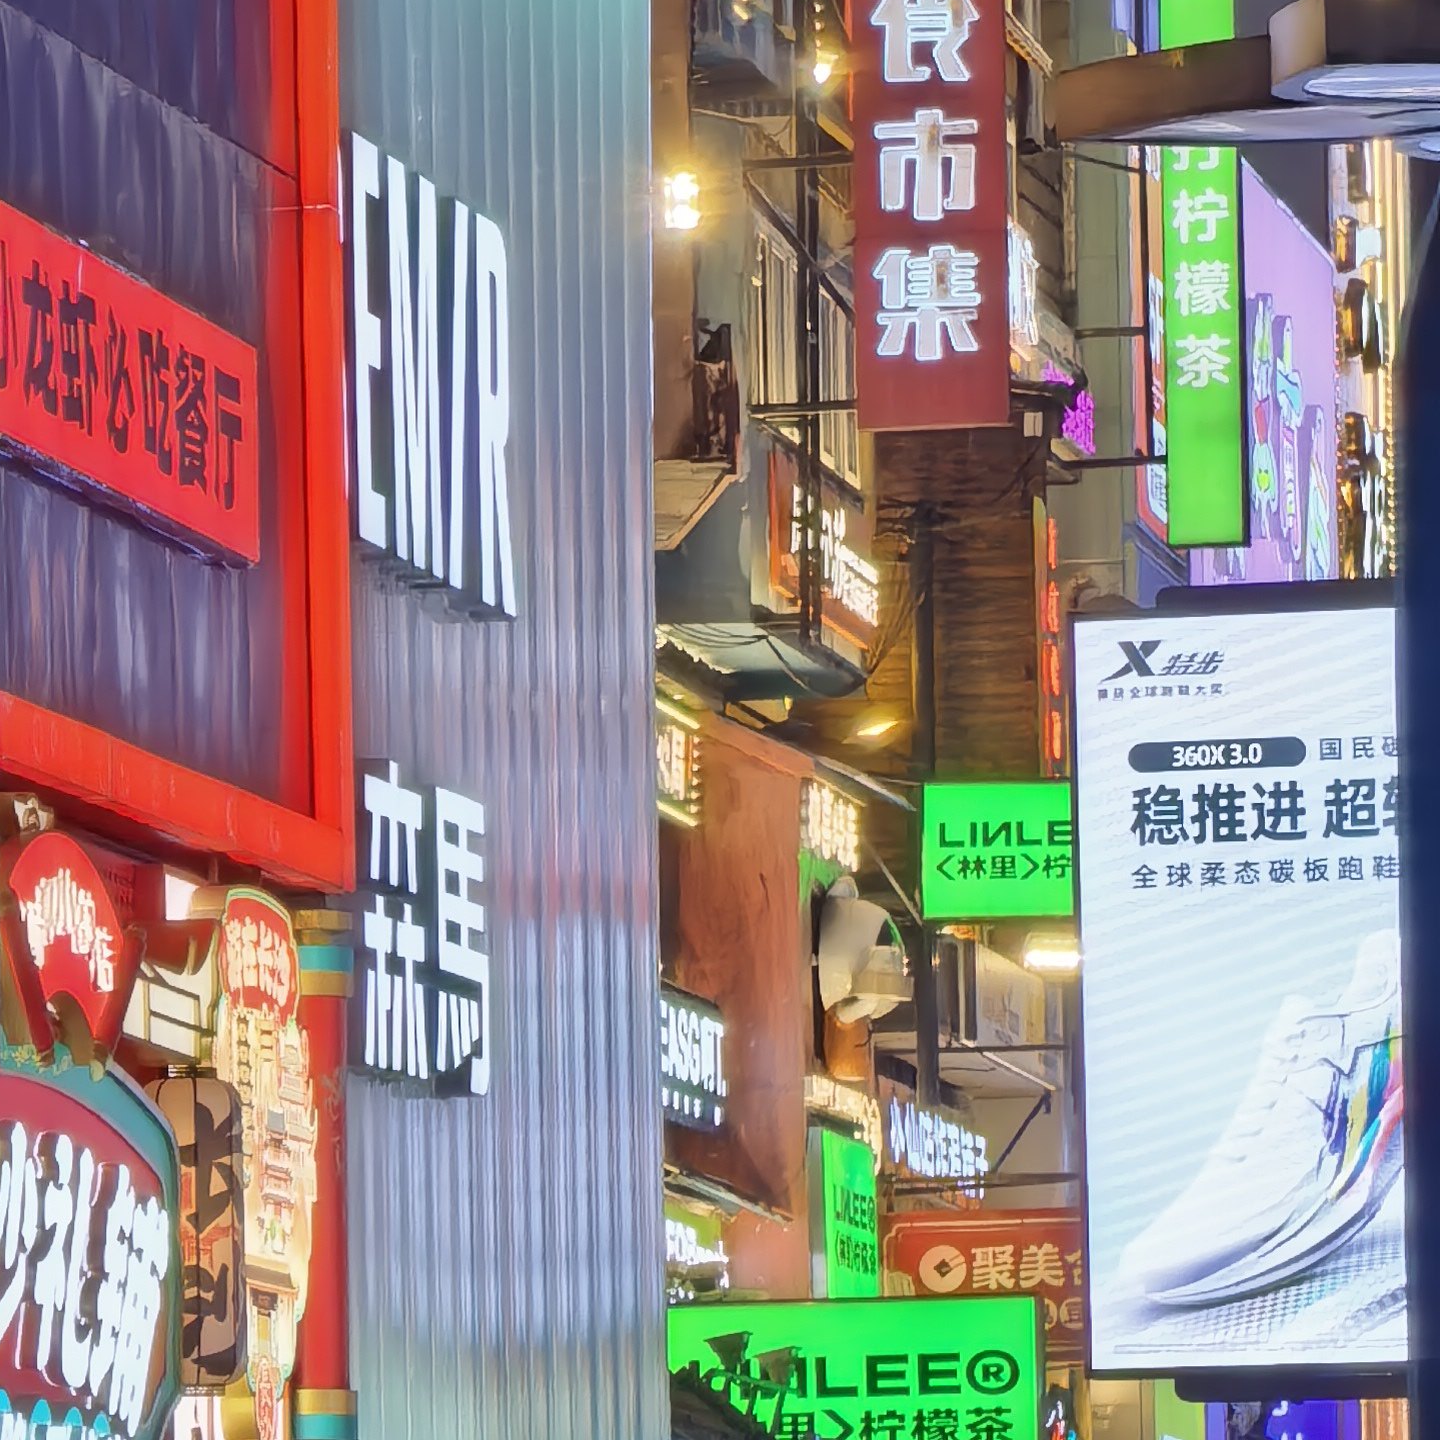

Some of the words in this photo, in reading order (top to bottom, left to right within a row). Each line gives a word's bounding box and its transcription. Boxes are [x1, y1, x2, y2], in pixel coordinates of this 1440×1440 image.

[342, 130, 517, 620] EMIR
[1172, 744, 1227, 768] 360X
[1229, 742, 1263, 766] 3.0
[1131, 780, 1308, 847] 稳推进
[1131, 853, 1400, 889] 全球柔态碳板跑鞋
